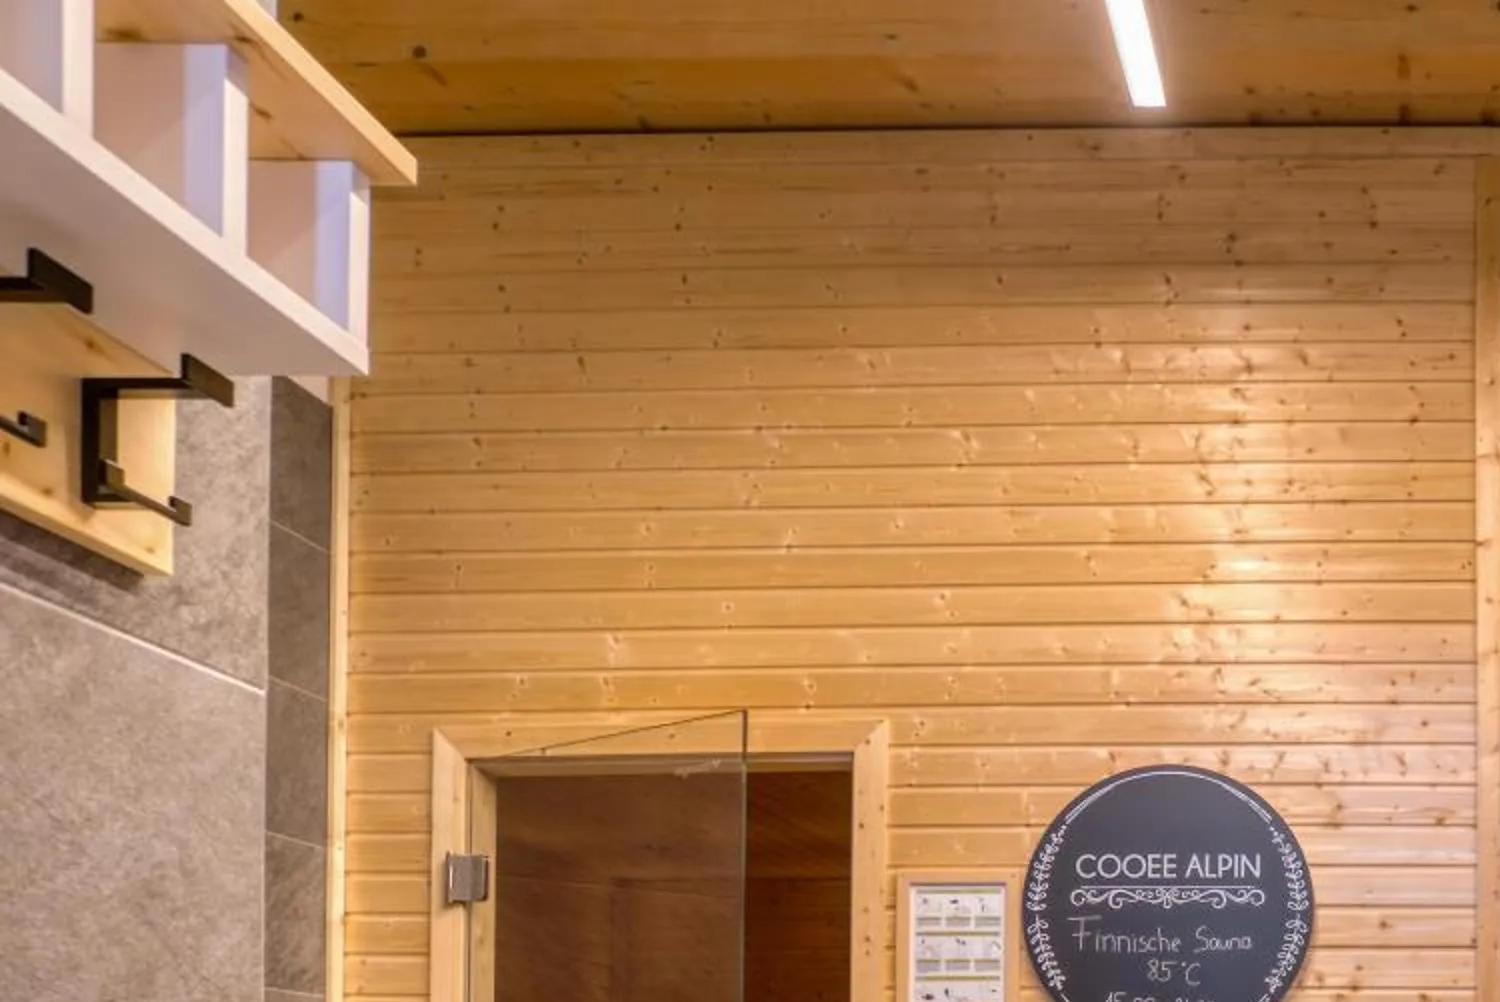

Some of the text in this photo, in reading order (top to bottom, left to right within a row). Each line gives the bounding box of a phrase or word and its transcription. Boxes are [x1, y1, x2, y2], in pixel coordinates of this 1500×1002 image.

[1075, 853, 1261, 879] COOEE ALPIN
[1067, 916, 1252, 953] Finnische Sauna
